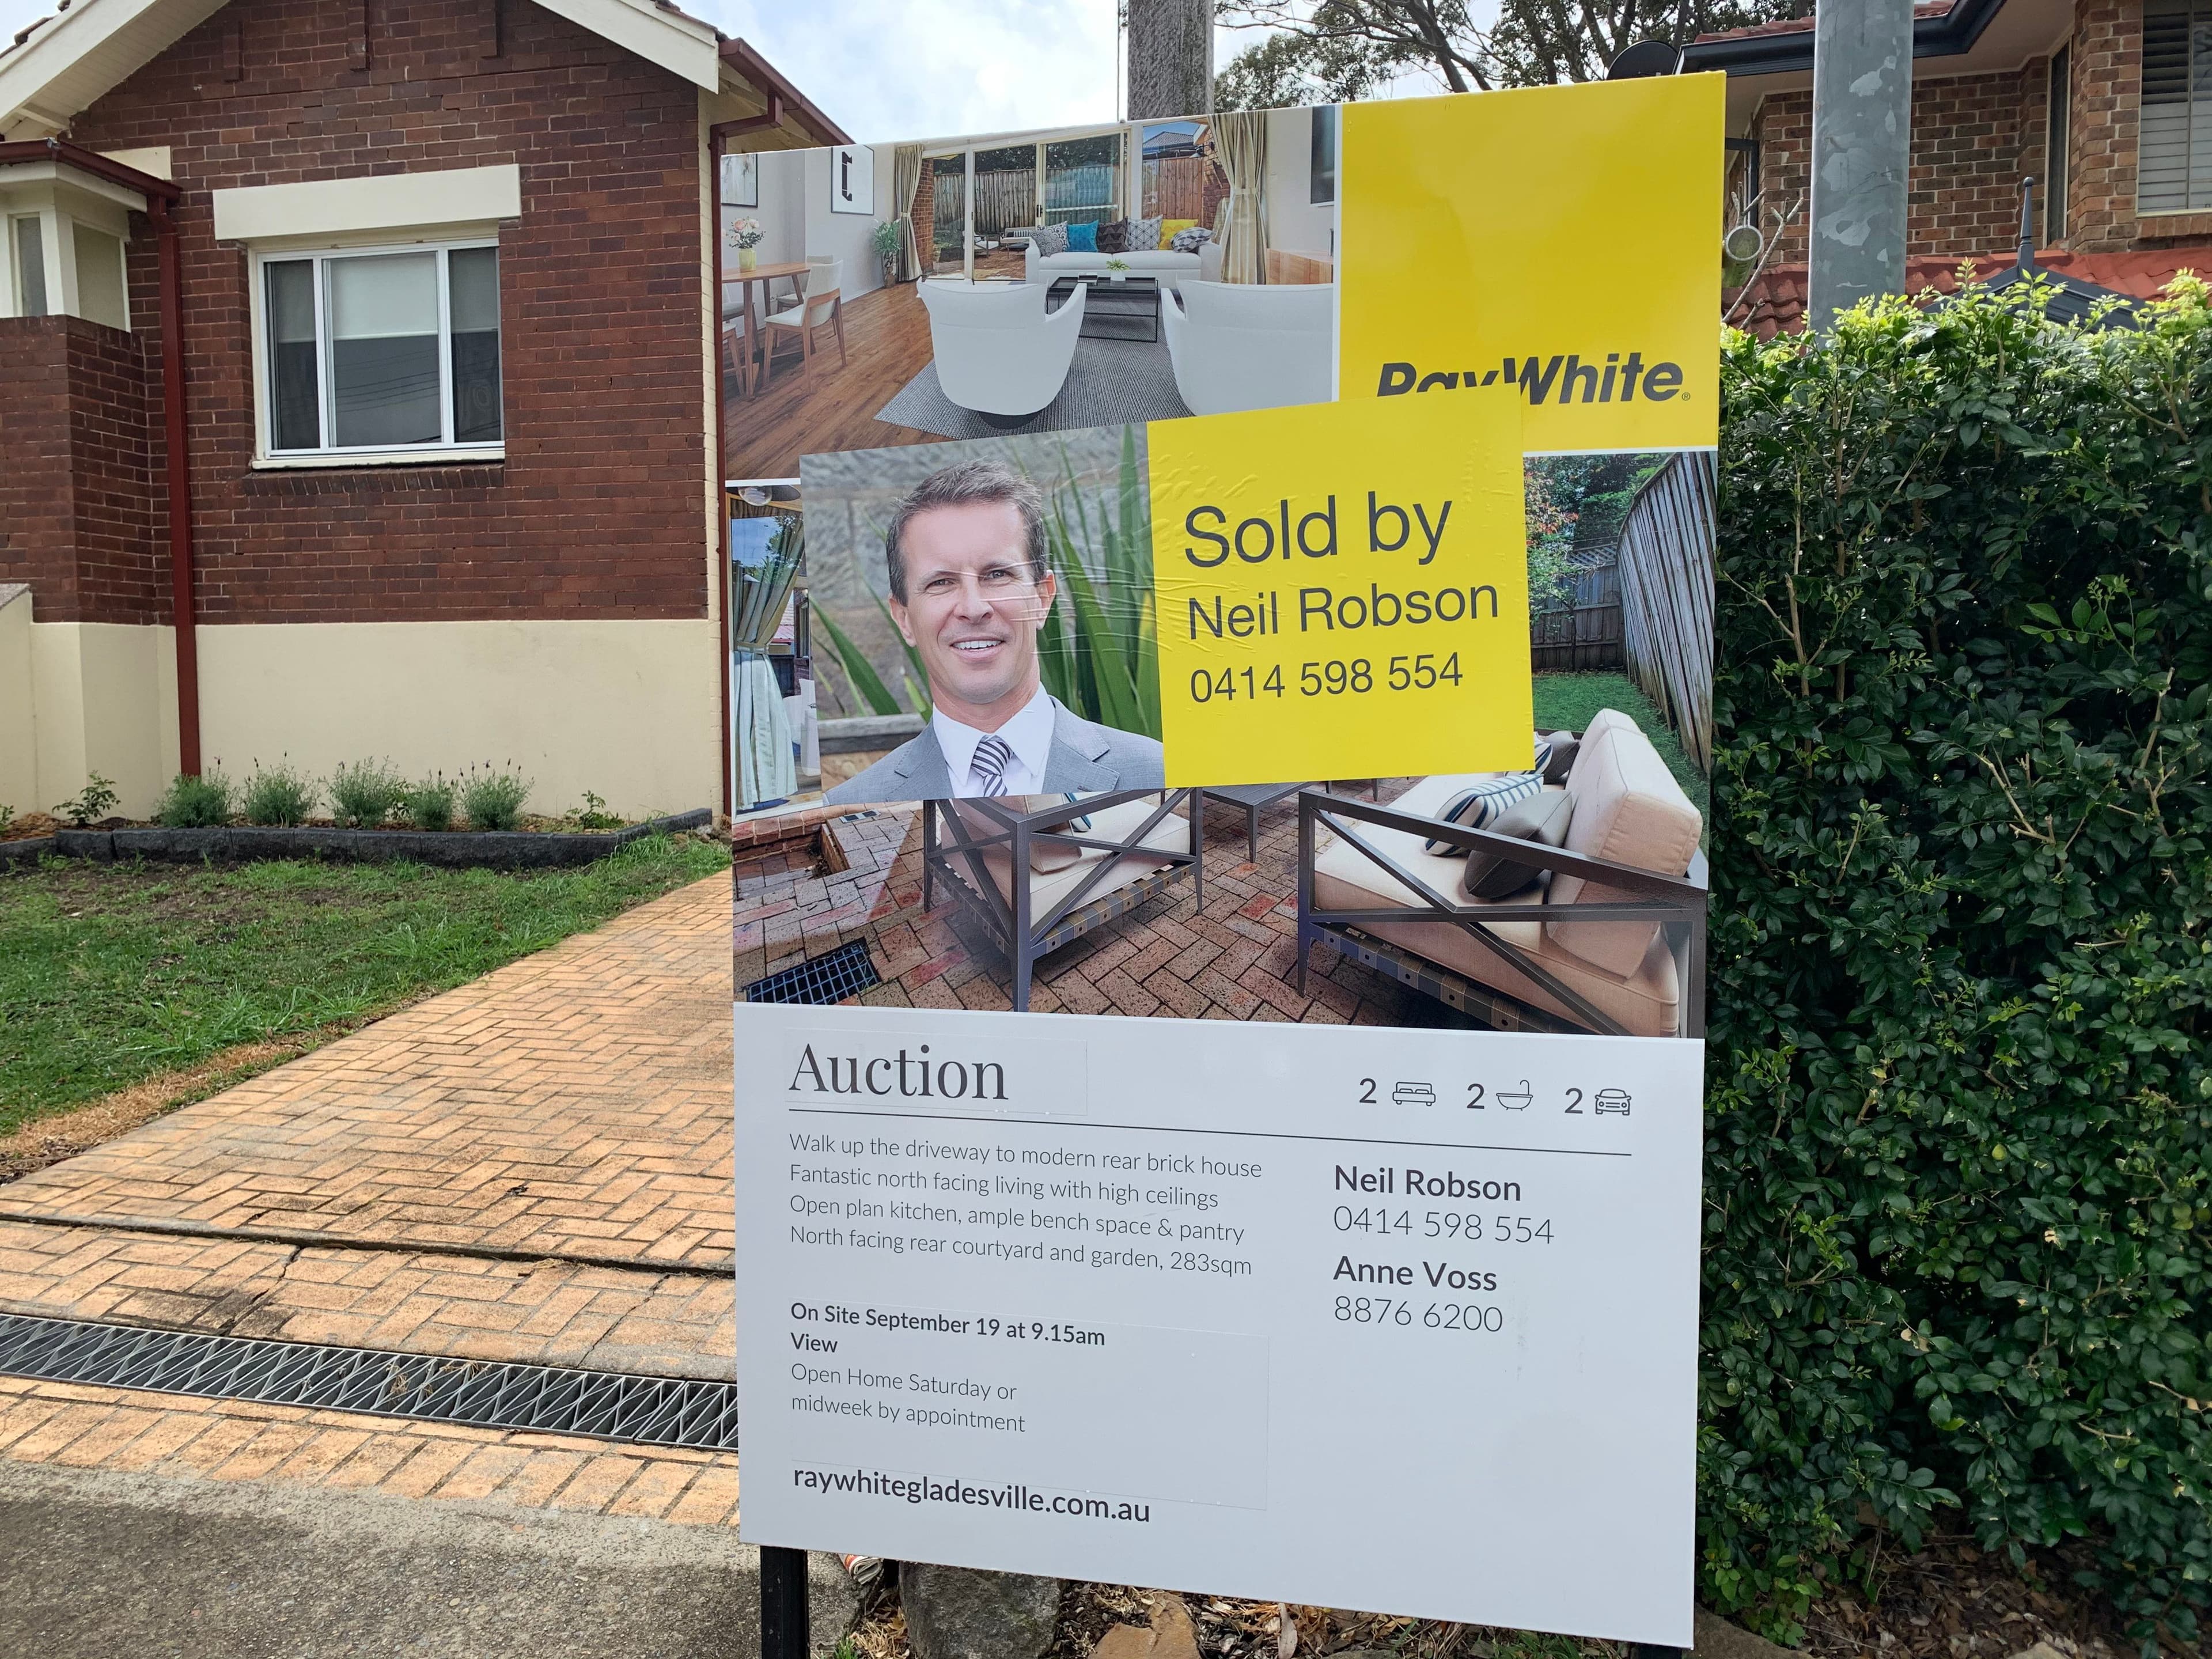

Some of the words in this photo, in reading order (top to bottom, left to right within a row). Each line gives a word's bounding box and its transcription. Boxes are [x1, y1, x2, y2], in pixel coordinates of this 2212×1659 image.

[1184, 494, 1338, 568] Sold
[1368, 490, 1453, 566] by
[1188, 590, 1278, 640] Neil
[1299, 582, 1498, 632] Robson
[1191, 664, 1286, 703] 0414
[1300, 658, 1373, 696] 598
[1388, 652, 1463, 691] 554
[788, 1043, 1009, 1100] Auction
[1359, 1078, 1377, 1104] 2
[1466, 1083, 1485, 1109] 2
[1564, 1088, 1584, 1114] 2
[789, 1133, 836, 1153] Walk
[842, 1141, 864, 1158] up
[869, 1137, 899, 1156] the
[906, 1139, 990, 1165] driveway
[995, 1145, 1015, 1162] to
[1022, 1147, 1095, 1168] modern
[1103, 1155, 1141, 1170] rear
[1147, 1152, 1195, 1173] brick
[1202, 1156, 1262, 1177] house
[791, 1164, 872, 1185] Fantastic
[878, 1170, 927, 1189] north
[933, 1172, 990, 1196] facing
[996, 1175, 1044, 1200] living
[1050, 1180, 1091, 1199] with
[1099, 1181, 1139, 1206] high
[1146, 1186, 1218, 1211] ceilings
[1335, 1165, 1393, 1194] Neil
[1406, 1169, 1521, 1202] Robson
[790, 1195, 839, 1217] Open
[847, 1198, 884, 1219] plan
[891, 1200, 961, 1225] kitchen,
[968, 1207, 1024, 1229] ample
[1031, 1209, 1089, 1231] bench
[1096, 1218, 1151, 1236] space
[1157, 1218, 1173, 1237] &
[1180, 1223, 1244, 1246] pantry
[1334, 1206, 1413, 1236] 0414
[1424, 1211, 1482, 1240] 598
[1495, 1216, 1555, 1244] 554
[791, 1225, 843, 1246] North
[849, 1229, 904, 1254] facing
[910, 1237, 947, 1252] rear
[952, 1240, 1043, 1261] courtyard
[1050, 1244, 1084, 1263] and
[1091, 1248, 1163, 1271] garden,
[1170, 1251, 1251, 1278] 283sqm
[1332, 1255, 1413, 1286] Anne
[1422, 1261, 1497, 1291] Voss
[791, 1302, 819, 1321] On
[824, 1305, 860, 1324] Site
[865, 1308, 970, 1334] September
[976, 1317, 1000, 1336] 19
[1006, 1322, 1026, 1339] at
[1032, 1322, 1105, 1346] 9.15am
[1335, 1296, 1412, 1325] 8876
[1423, 1302, 1503, 1332] 6200
[790, 1332, 838, 1353] View
[791, 1363, 840, 1385] Open
[848, 1368, 903, 1389] Home
[909, 1373, 991, 1402] Saturday
[997, 1387, 1017, 1400] or
[792, 1394, 873, 1417] midweek
[878, 1400, 900, 1423] by
[906, 1408, 1025, 1433] appointment
[794, 1469, 1149, 1522] raywhitegladesville.com.au
